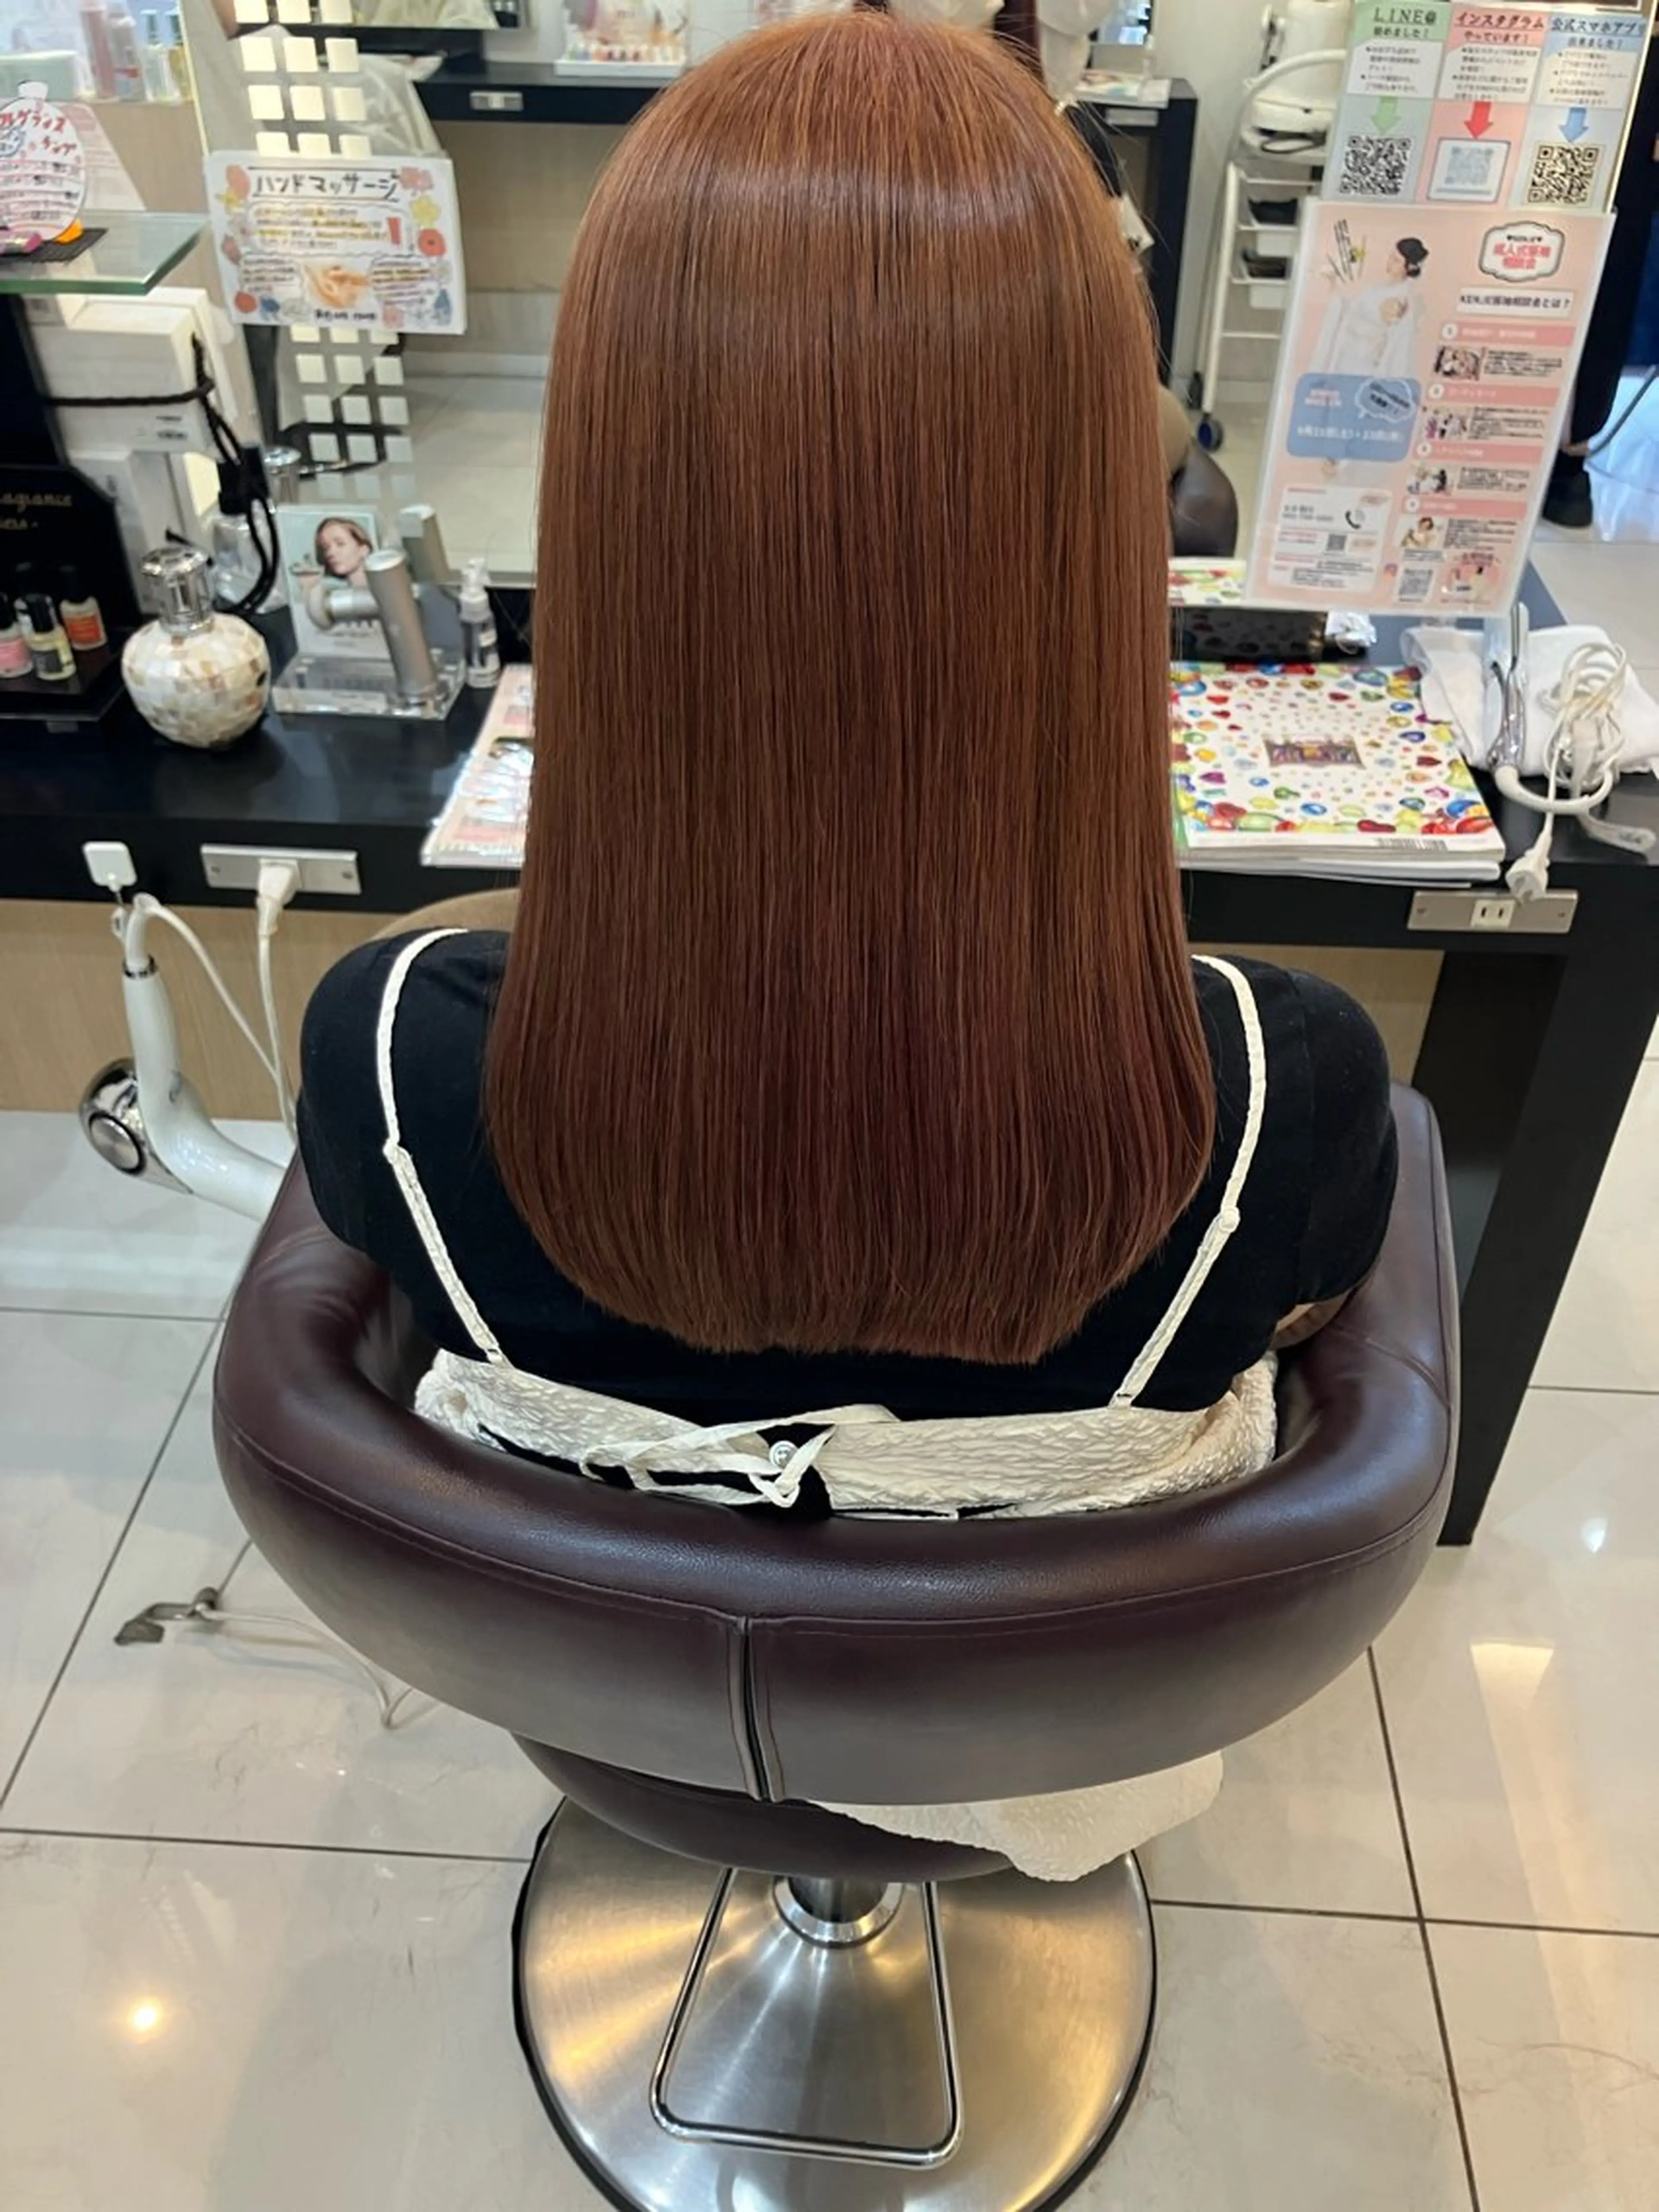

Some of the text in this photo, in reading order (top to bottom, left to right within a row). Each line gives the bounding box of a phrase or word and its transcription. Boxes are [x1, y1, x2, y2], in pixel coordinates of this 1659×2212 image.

[1456, 12, 1545, 29] インスタグラム
[255, 172, 400, 200] ハンドマッサージ
[0, 493, 72, 513] agrance
